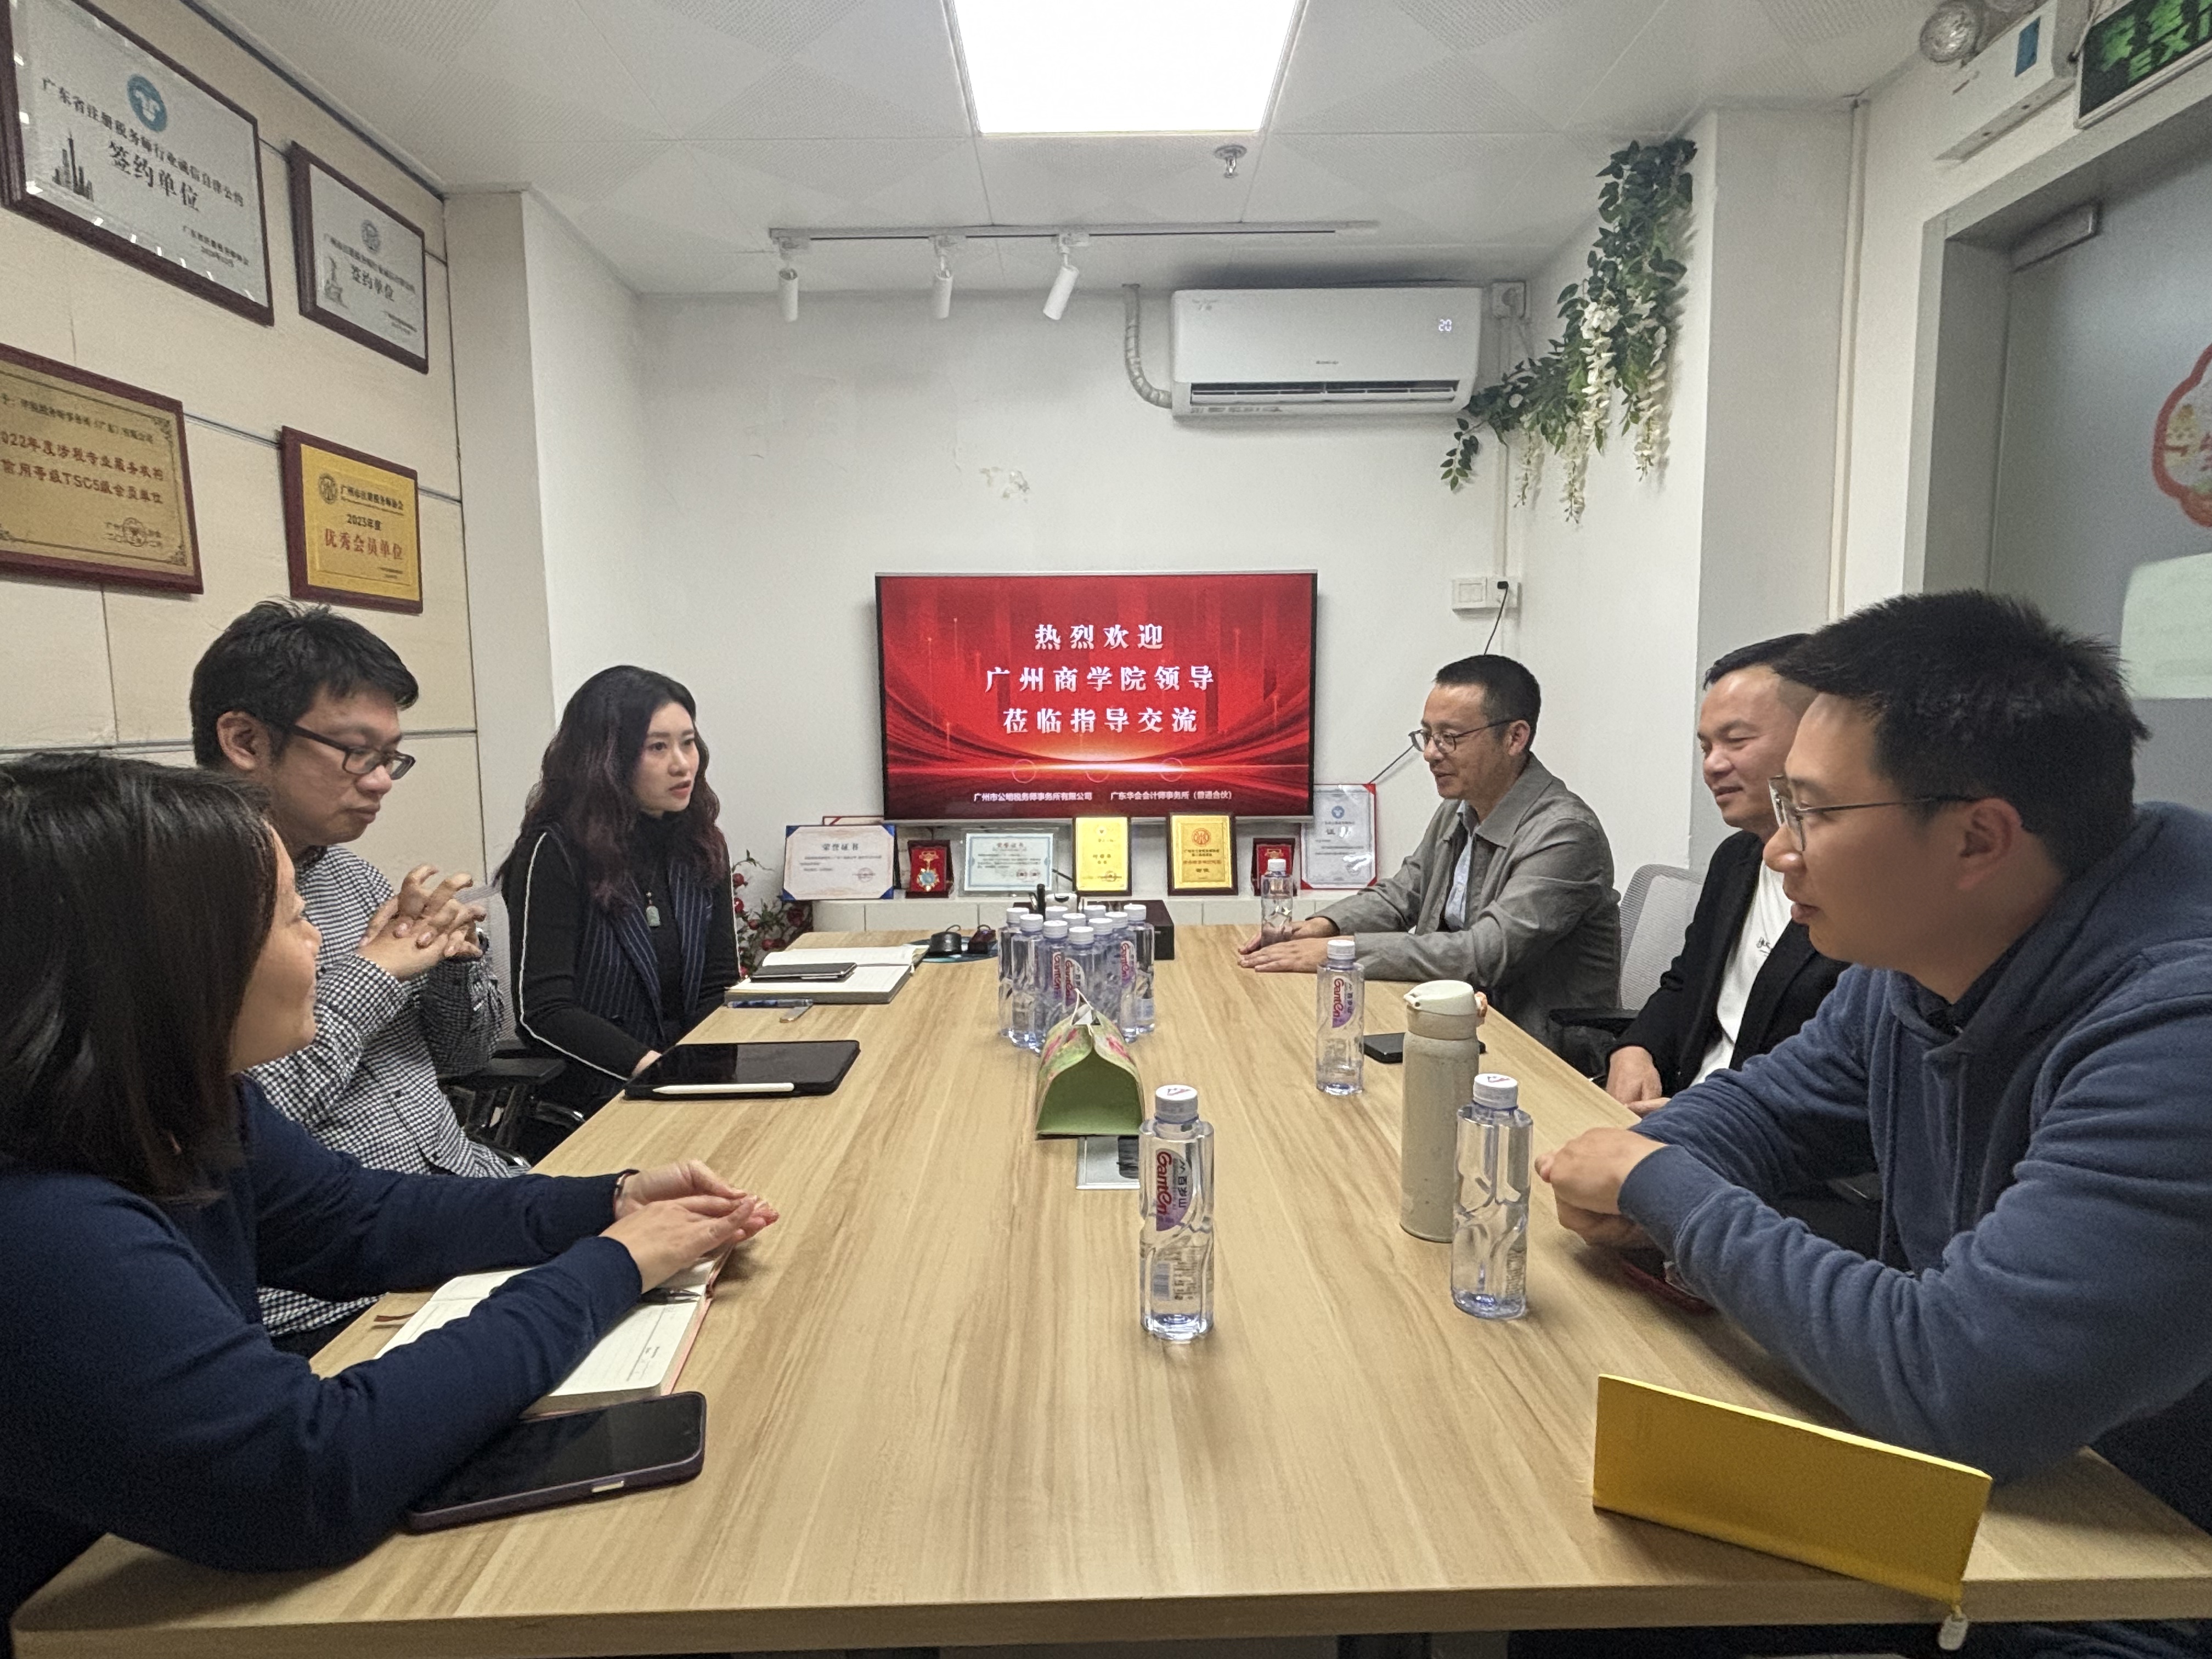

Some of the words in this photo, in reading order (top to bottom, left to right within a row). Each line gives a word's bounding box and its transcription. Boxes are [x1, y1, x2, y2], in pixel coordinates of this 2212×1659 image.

[109, 140, 200, 212] 签约单位
[1438, 319, 1452, 331] 20
[325, 528, 403, 560] 优秀会员单位
[1035, 623, 1164, 650] 热烈欢迎
[985, 665, 1214, 693] 广州商学院领导
[1003, 707, 1198, 734] 莅临指导交流
[1178, 1176, 1187, 1209] 百岁山
